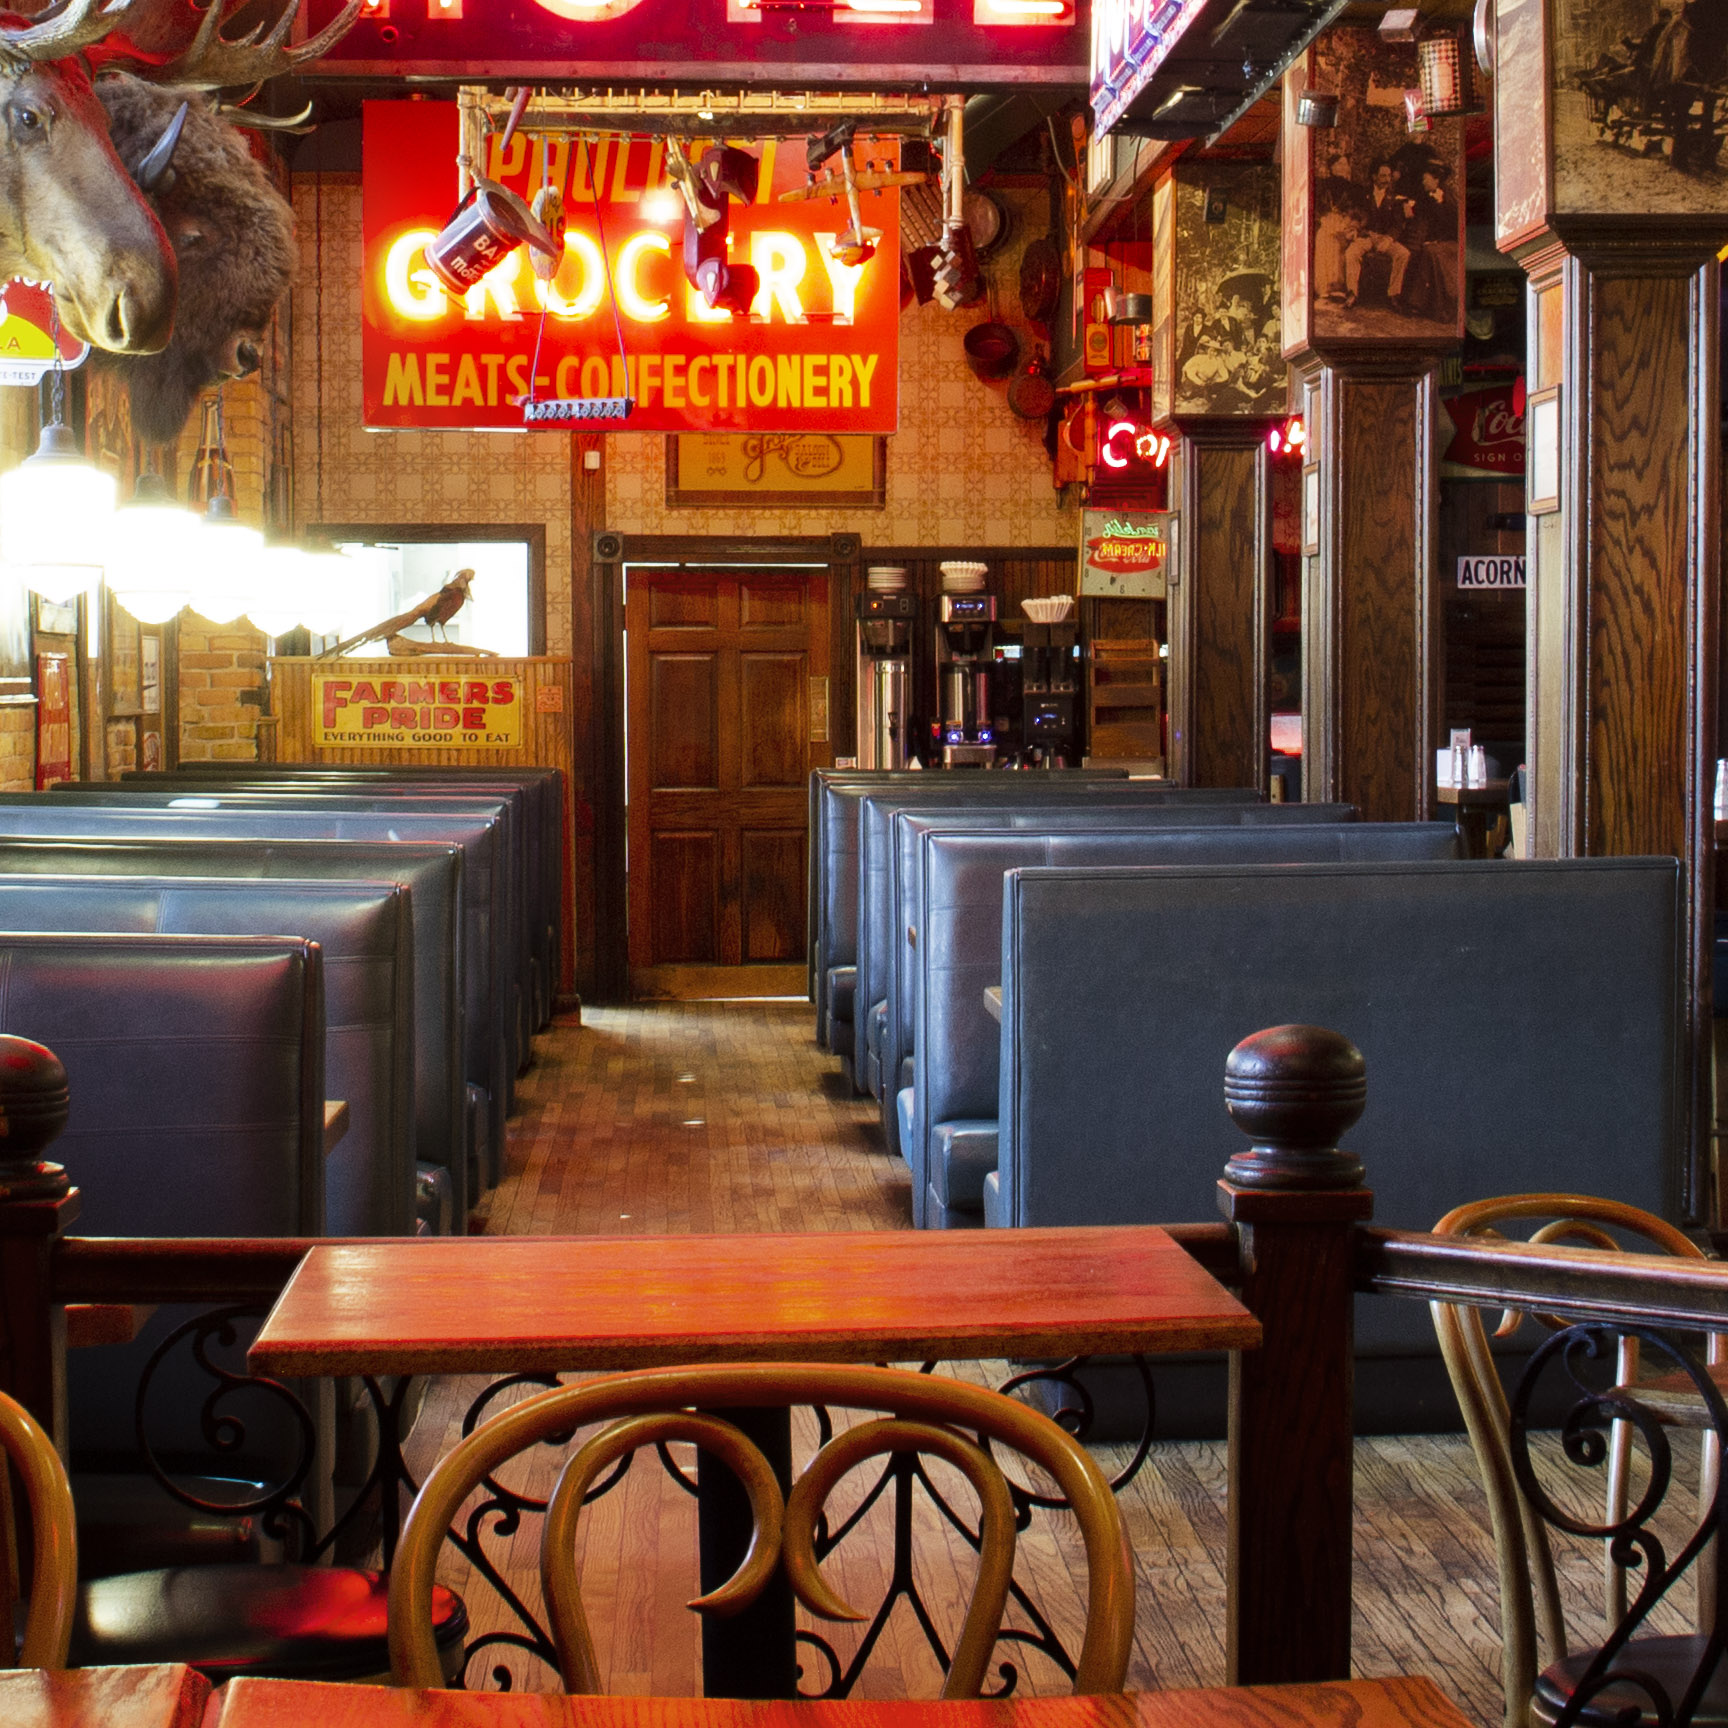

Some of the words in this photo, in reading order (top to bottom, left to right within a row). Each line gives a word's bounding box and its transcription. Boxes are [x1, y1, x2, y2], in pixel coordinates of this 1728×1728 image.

[1474, 453, 1506, 463] SIGN
[322, 680, 515, 729] FARMERS
[362, 706, 487, 730] PRIDE
[322, 731, 405, 744] EVERYTHING
[411, 731, 456, 743] GOOD
[461, 731, 479, 742] TO
[485, 731, 511, 743] EAT
